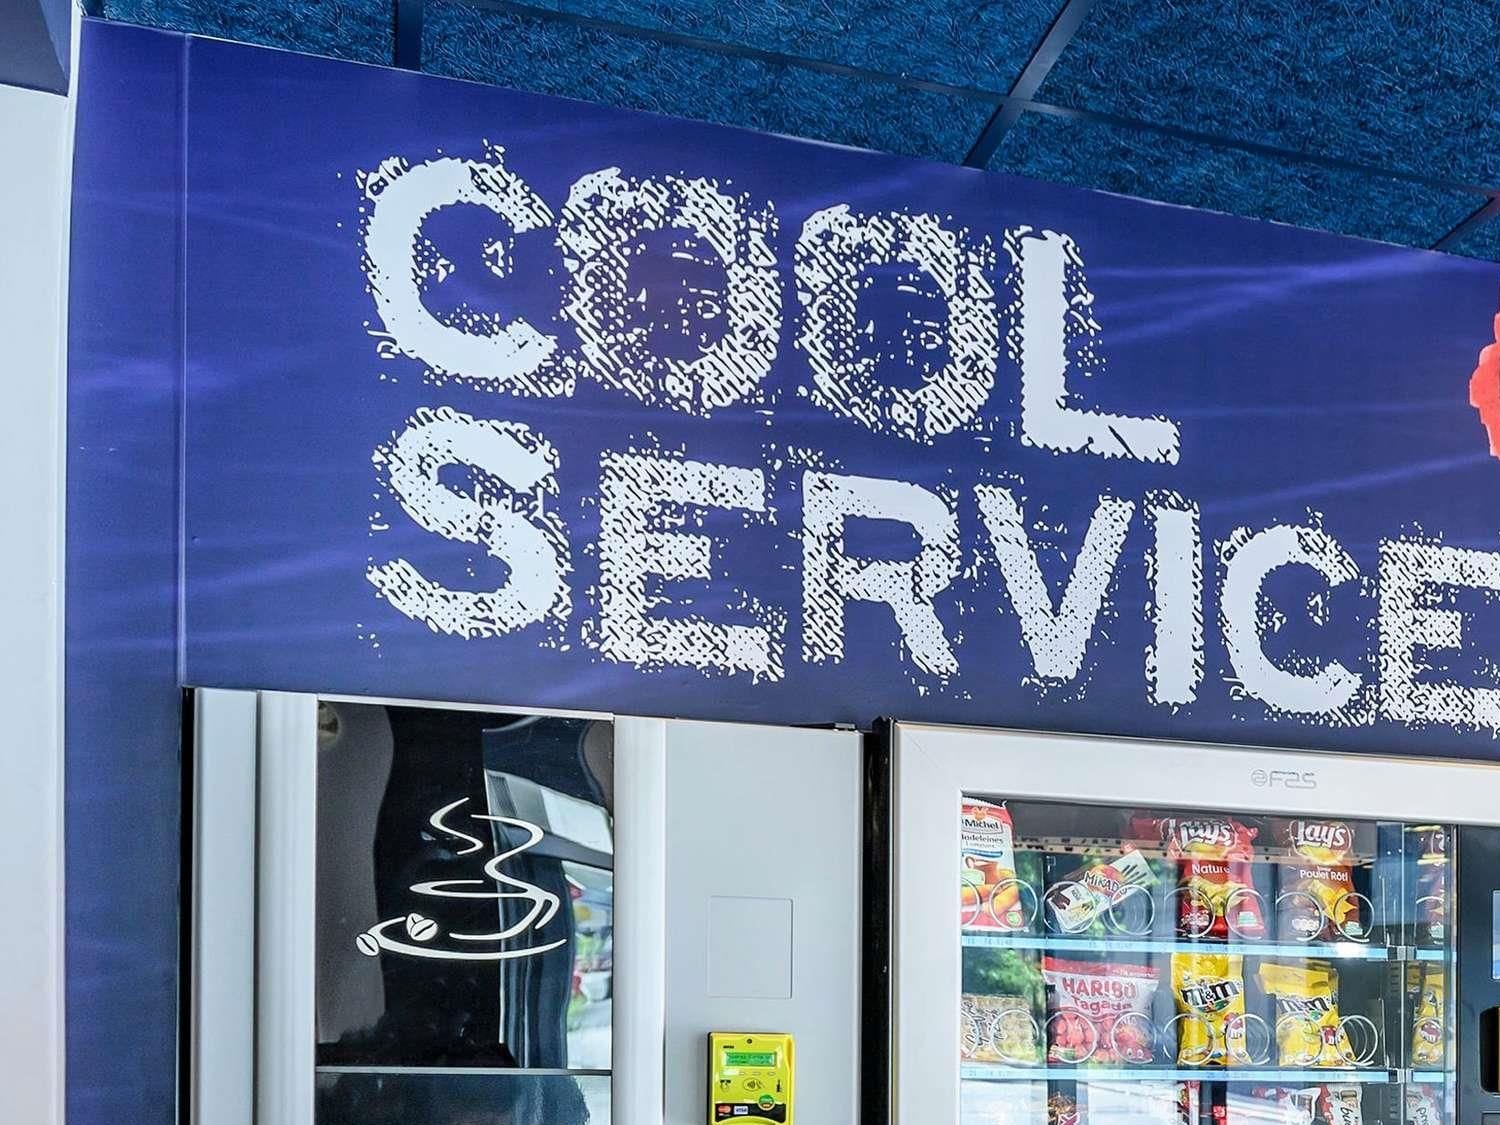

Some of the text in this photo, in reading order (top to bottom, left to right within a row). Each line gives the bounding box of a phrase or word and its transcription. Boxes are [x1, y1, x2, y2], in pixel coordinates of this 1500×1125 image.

[358, 146, 1180, 466] COOL
[1298, 821, 1346, 848] Lay's
[1300, 869, 1329, 882] Poulet
[1062, 977, 1136, 999] HARIBO
